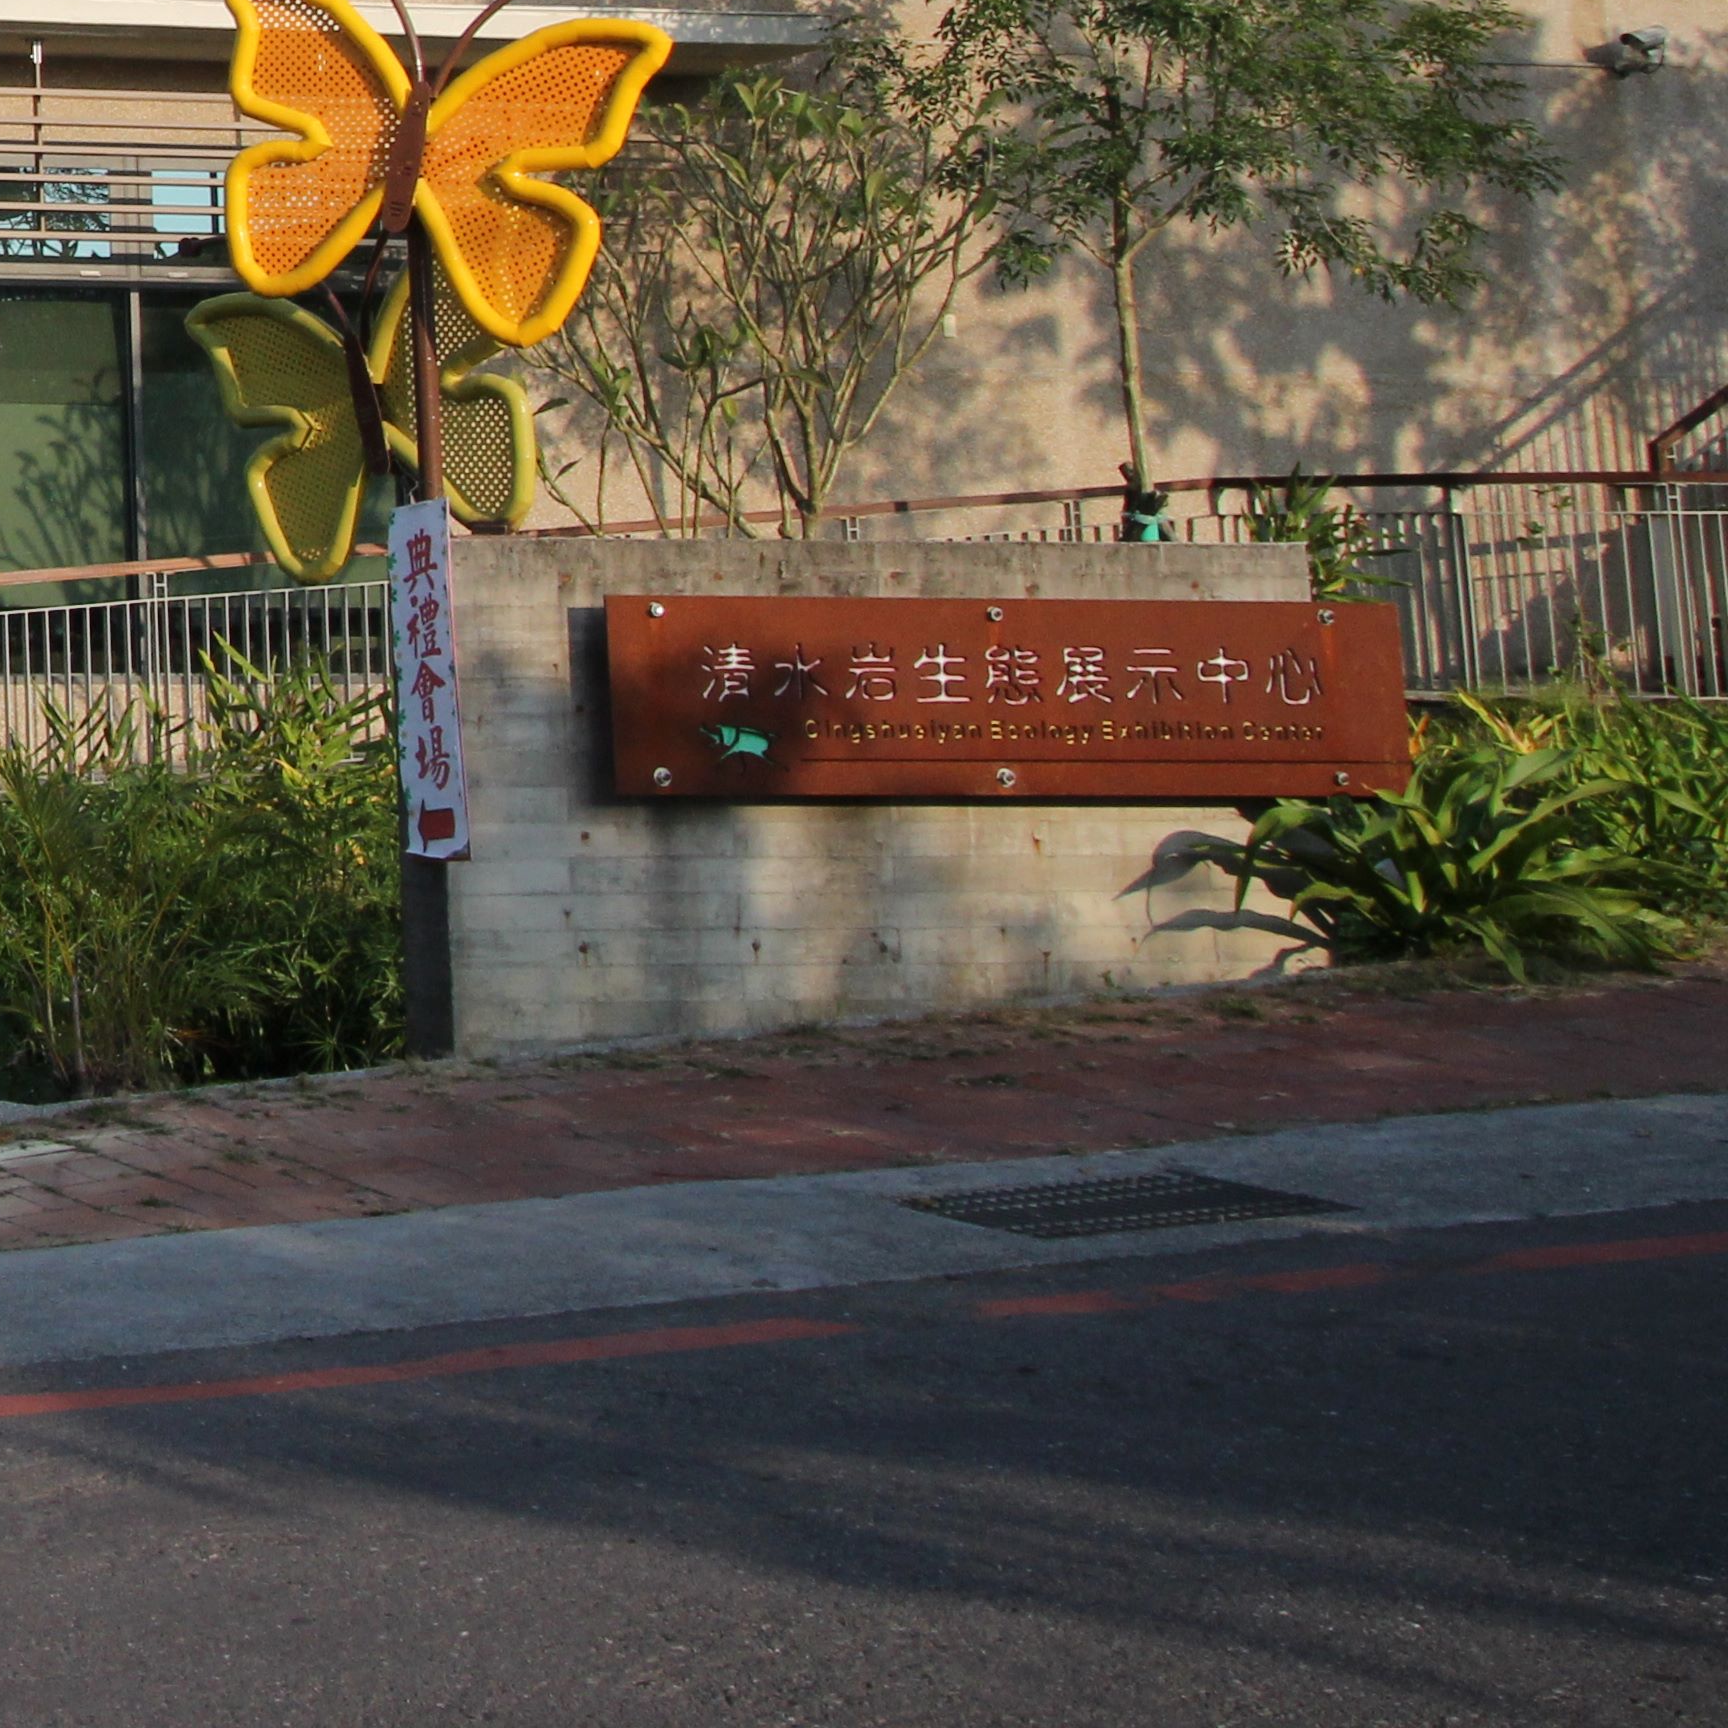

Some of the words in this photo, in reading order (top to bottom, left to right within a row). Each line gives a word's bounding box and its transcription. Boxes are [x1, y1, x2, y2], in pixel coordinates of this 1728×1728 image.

[401, 528, 451, 791] 典禮會場
[700, 642, 1322, 706] 清水岩生態展示中心
[989, 720, 1093, 745] Ecology
[1102, 720, 1235, 742] Exhibition
[1242, 720, 1324, 741] Center
